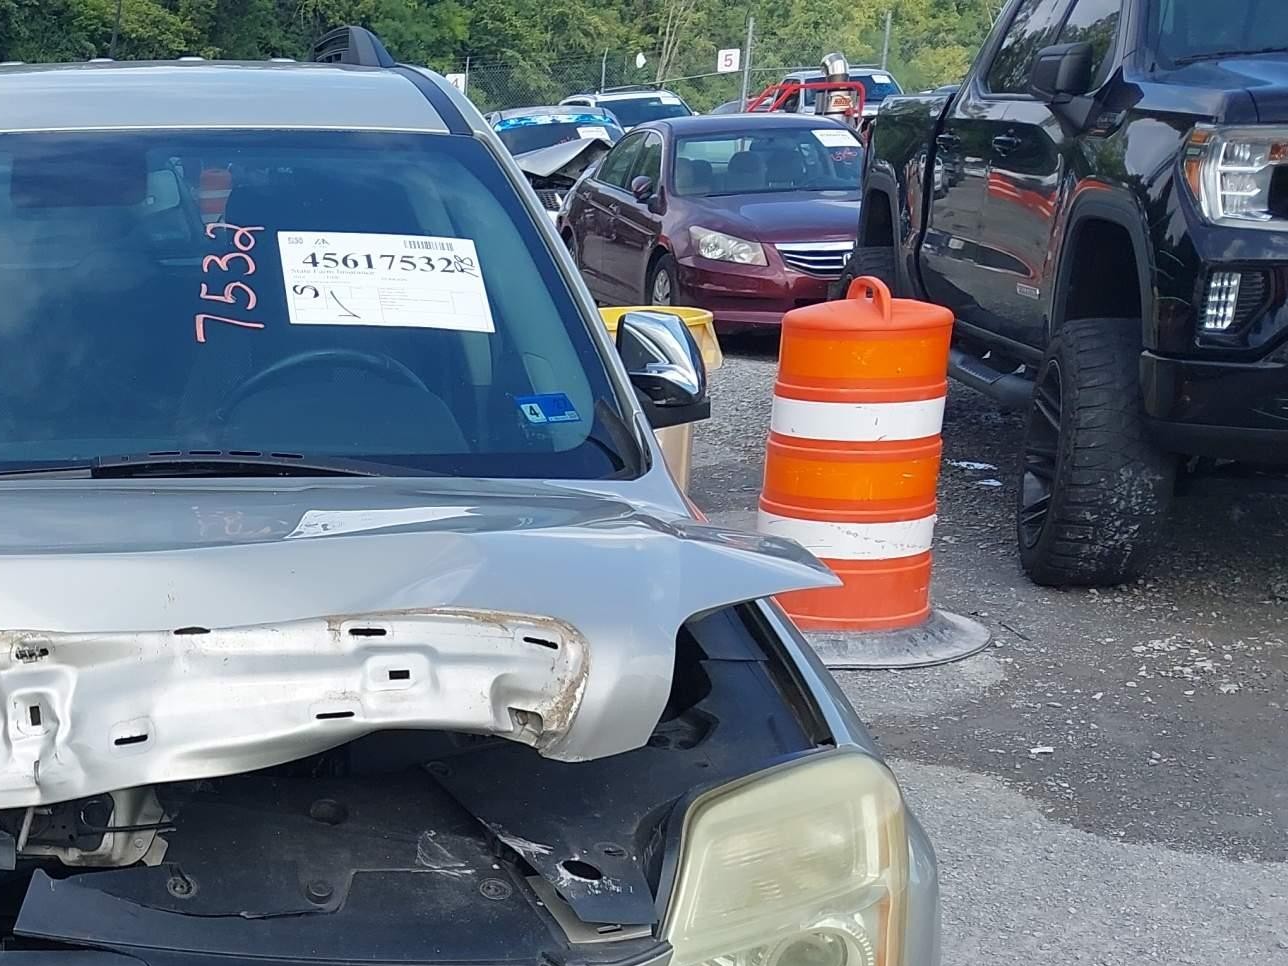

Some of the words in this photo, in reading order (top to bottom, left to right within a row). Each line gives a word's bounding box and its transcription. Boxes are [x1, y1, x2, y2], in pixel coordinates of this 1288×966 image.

[723, 53, 733, 68] 5
[302, 252, 456, 273] 45617532
[195, 222, 265, 343] 7532
[528, 405, 541, 418] 4
